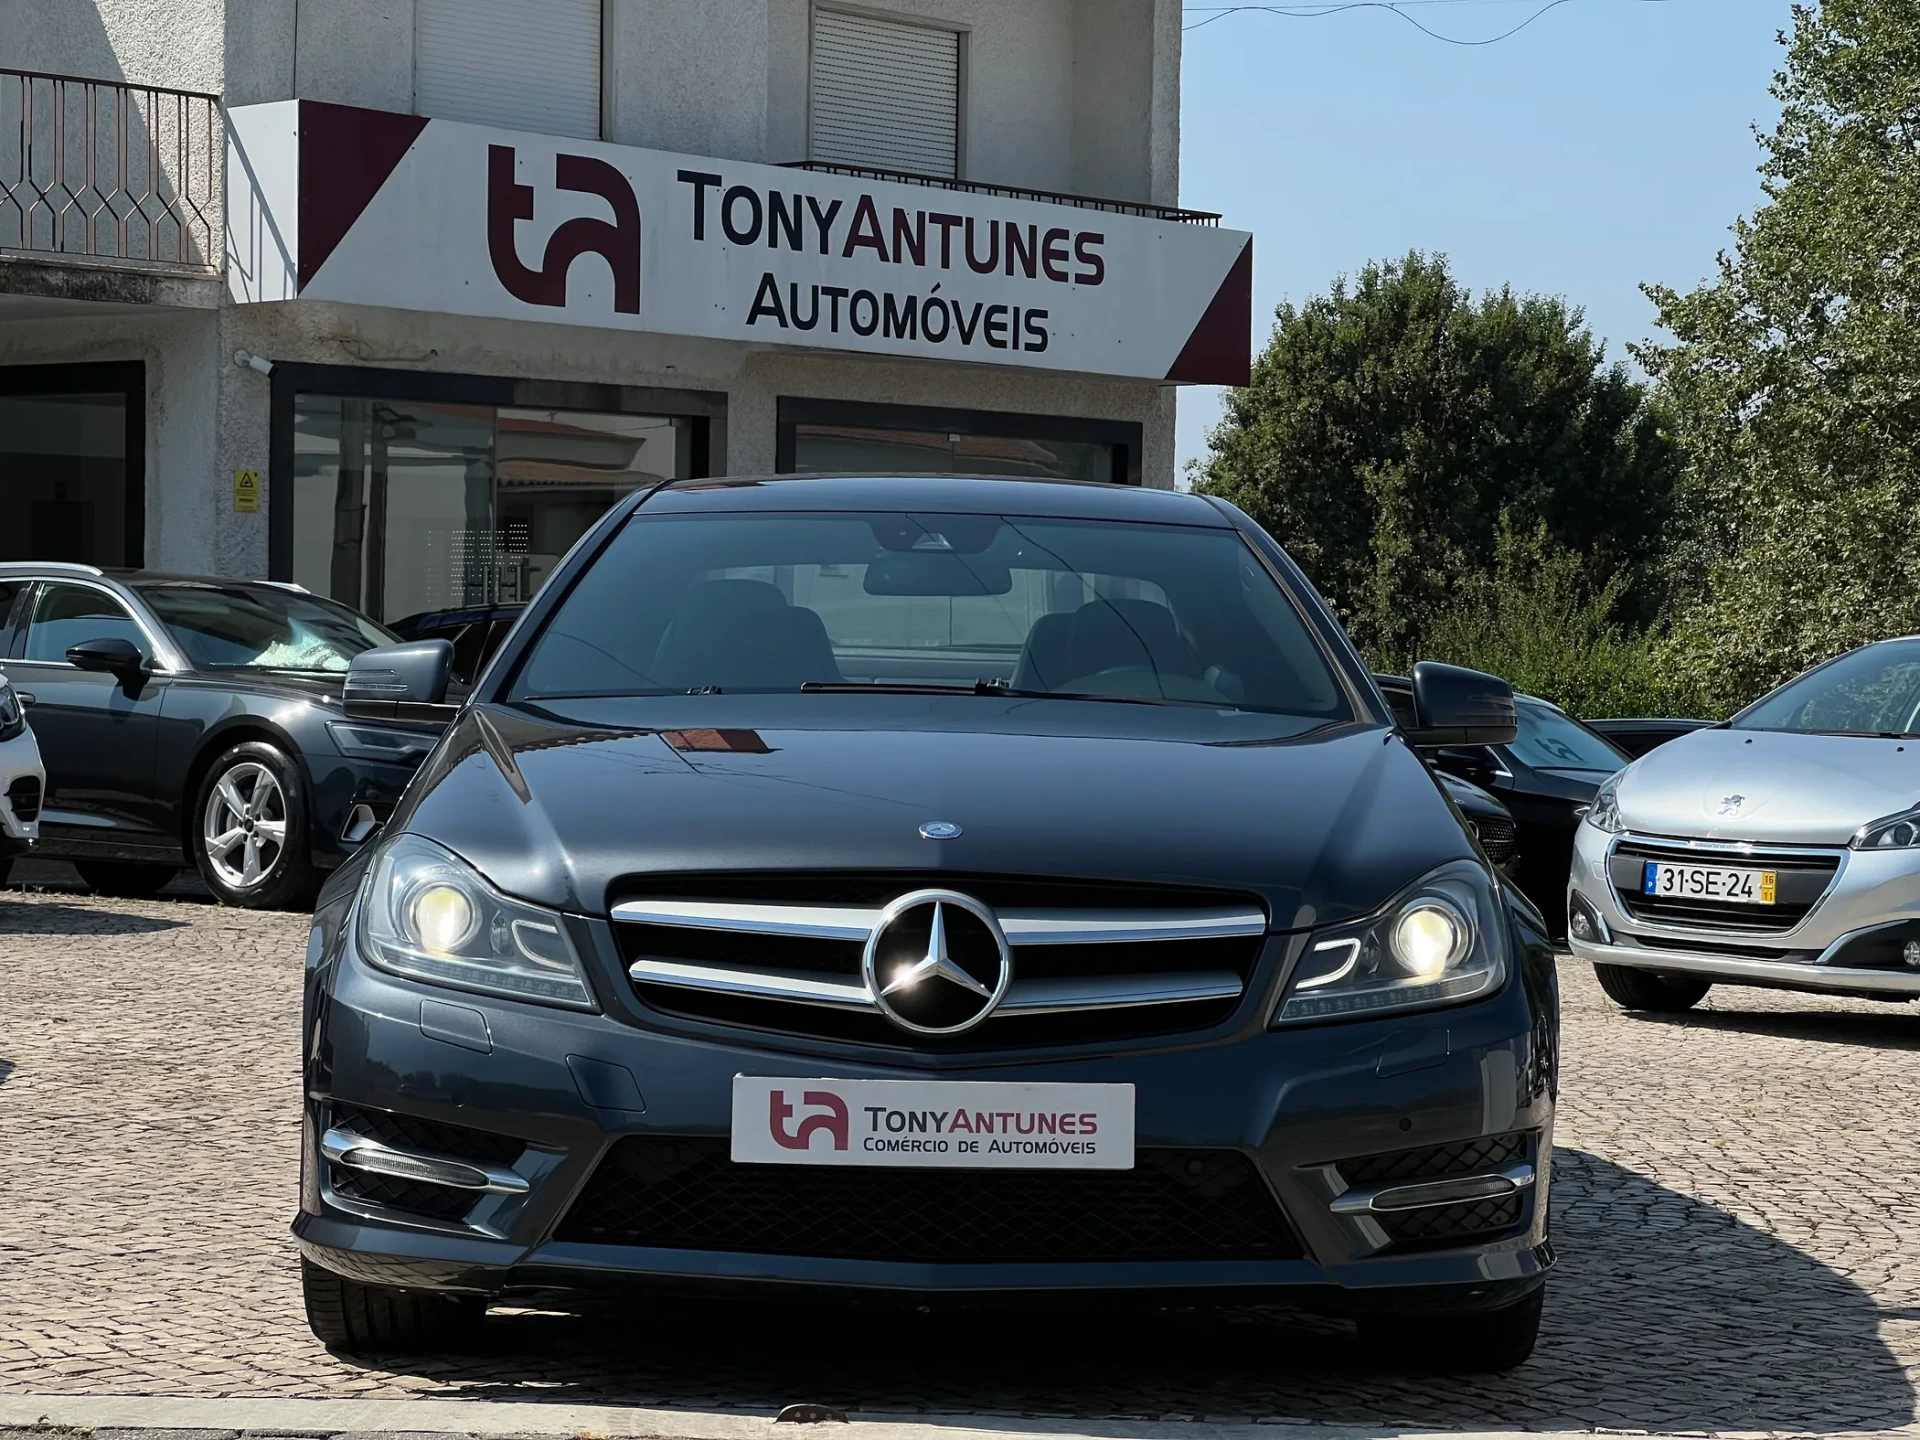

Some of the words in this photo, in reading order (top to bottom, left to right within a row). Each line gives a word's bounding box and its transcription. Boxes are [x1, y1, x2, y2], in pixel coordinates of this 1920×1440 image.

[745, 271, 1050, 354] AUTOMÓVEIS
[1764, 875, 1774, 884] 16
[1764, 891, 1773, 901] 11
[863, 1135, 949, 1153] COMÉRCIO
[957, 1140, 979, 1154] DE
[987, 1137, 1097, 1155] AUTOMÓVEIS
